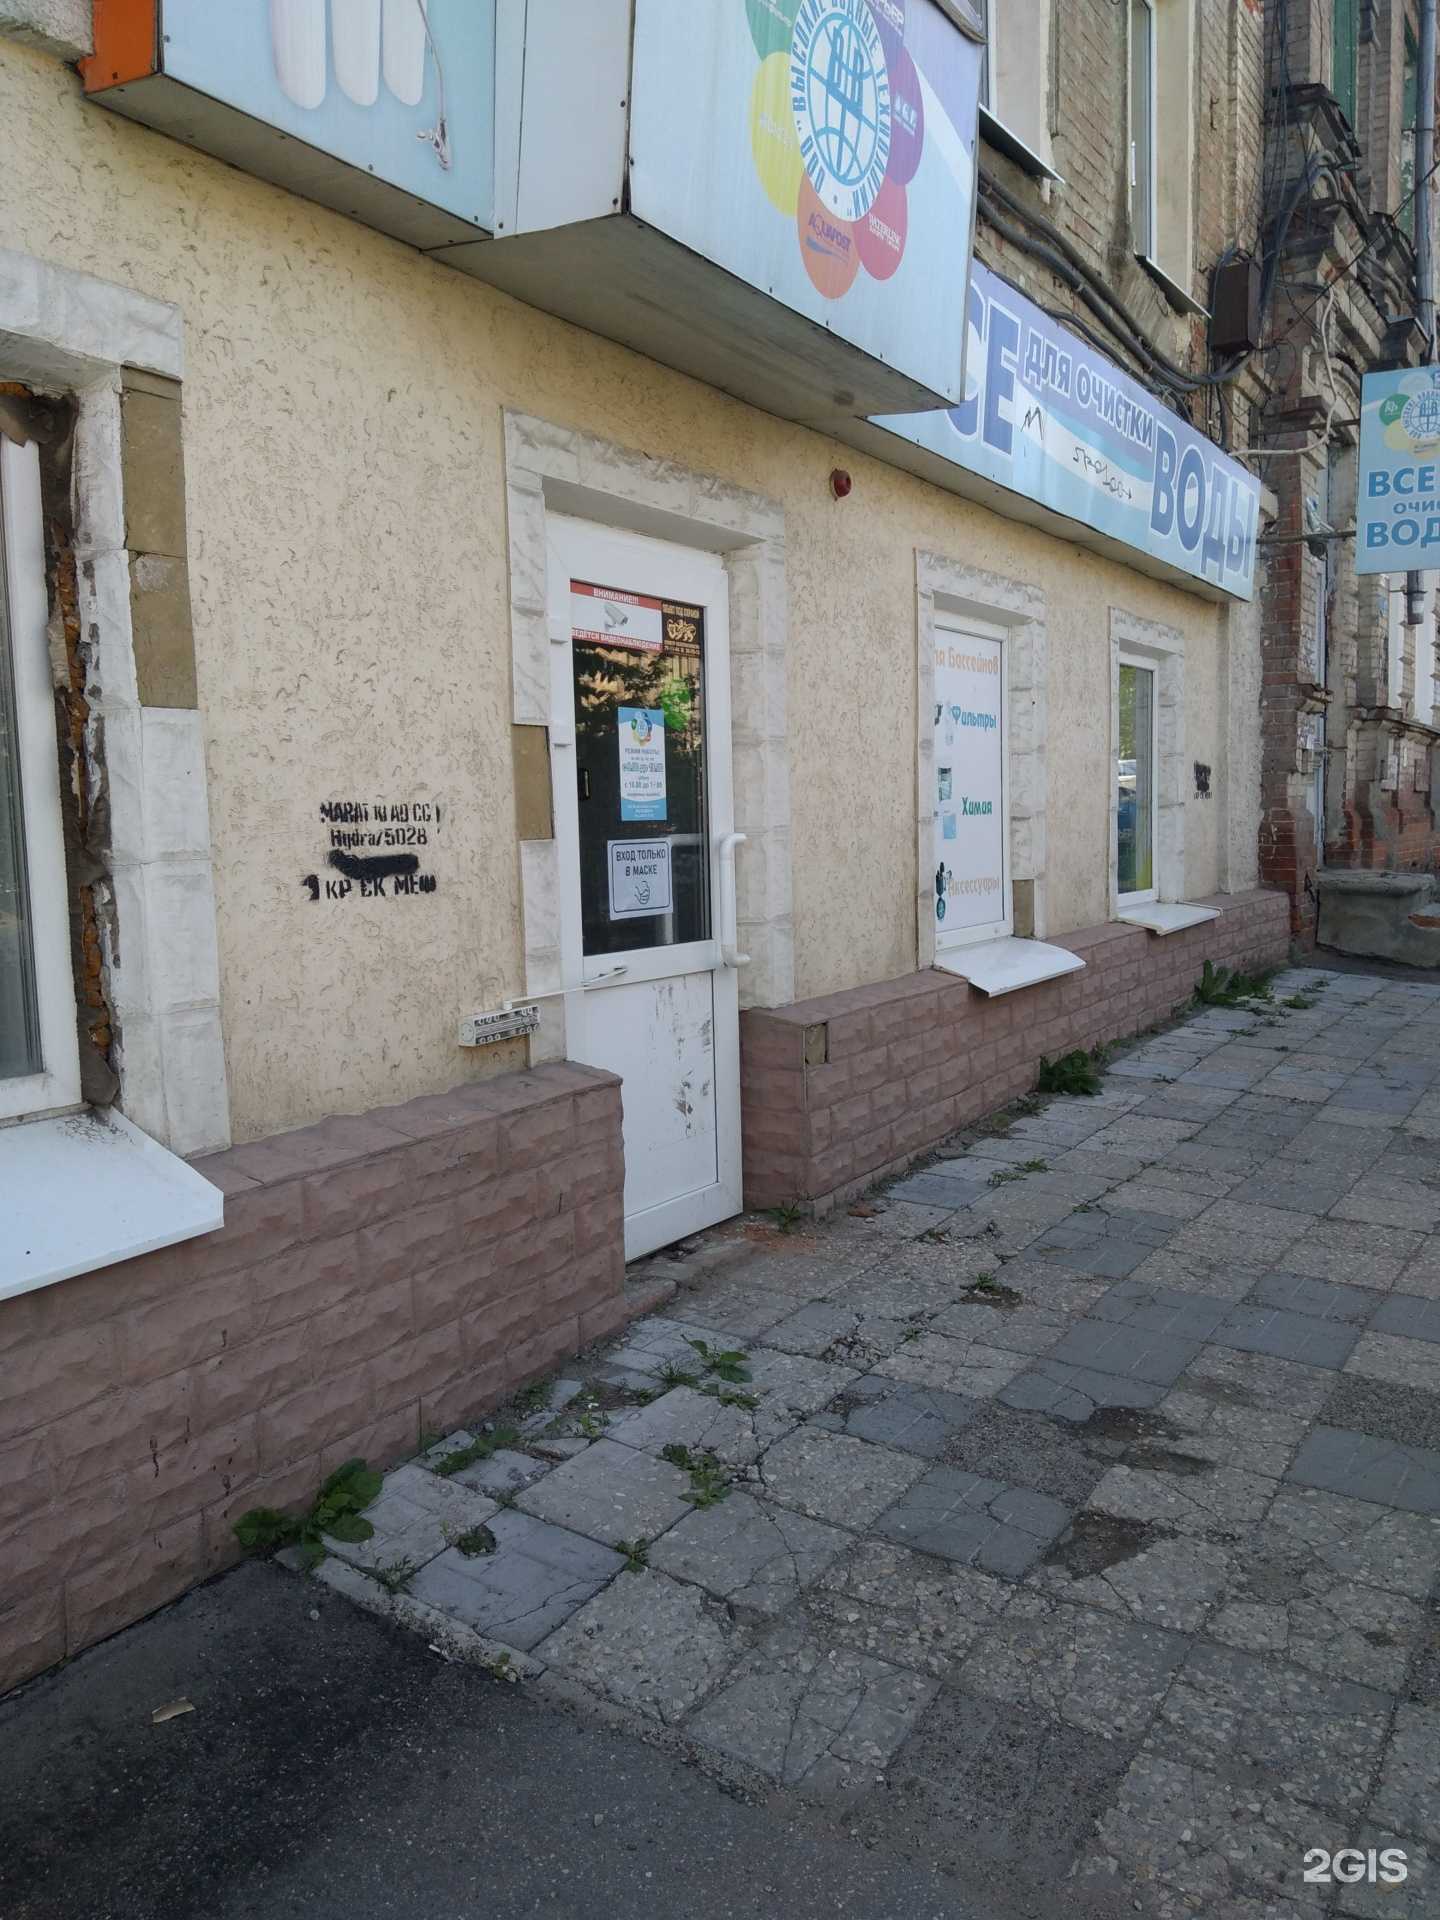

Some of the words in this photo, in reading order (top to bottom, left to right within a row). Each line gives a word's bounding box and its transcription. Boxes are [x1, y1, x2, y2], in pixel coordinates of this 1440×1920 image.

[1023, 327, 1071, 398] ДЛЯ
[1076, 363, 1154, 452] ОЧИСТКИ
[1366, 465, 1436, 498] ВСЕ
[1150, 418, 1257, 584] ВОДЫ
[1393, 500, 1440, 515] ОЧИ
[951, 705, 997, 732] Фильтры
[962, 797, 993, 816] Химия
[616, 850, 636, 862] ВХОД
[637, 848, 666, 860] ТОЛЬКО
[625, 866, 631, 877] В
[633, 864, 658, 876] МАСКЕ
